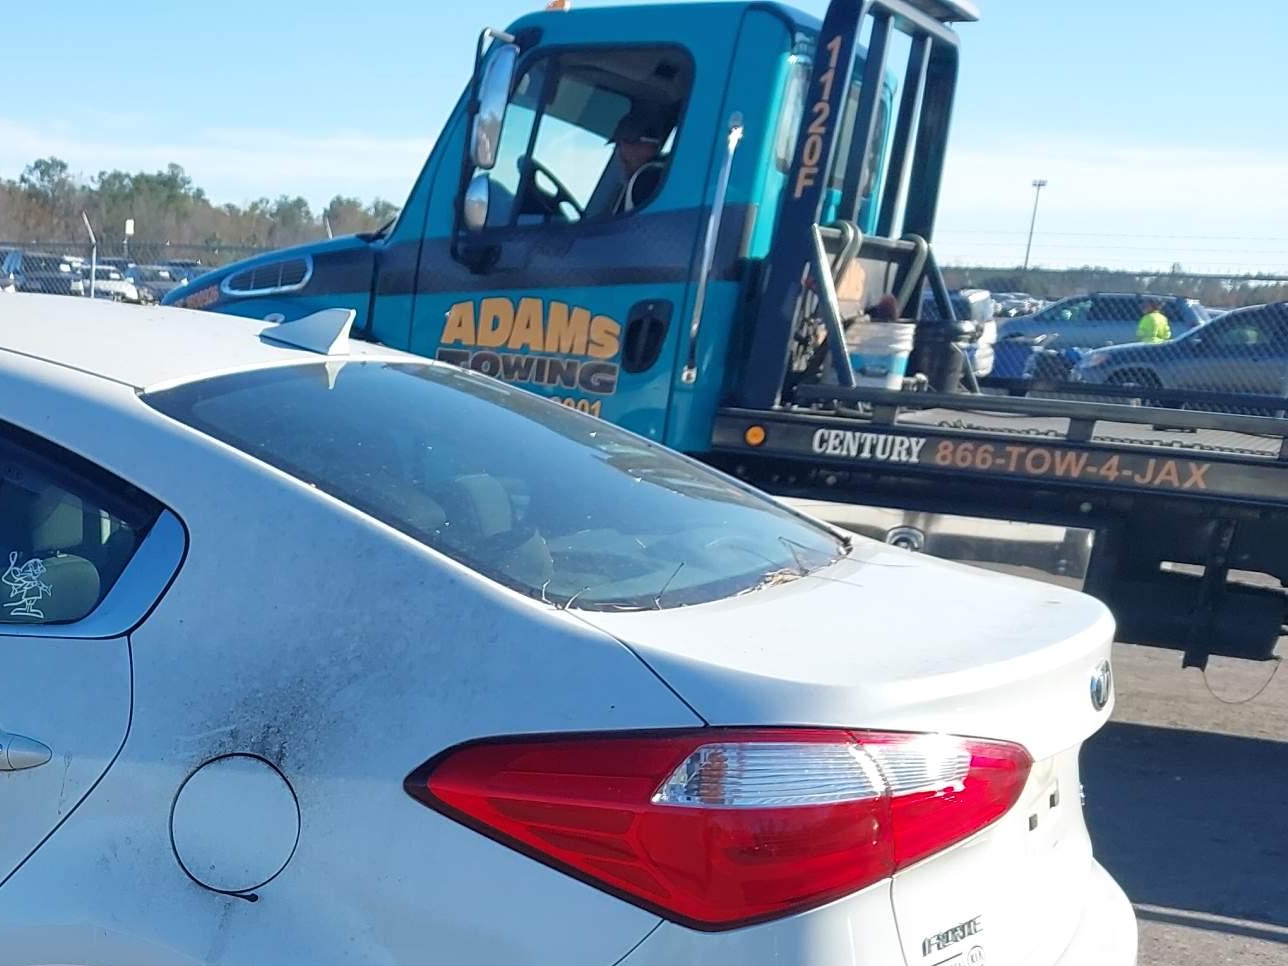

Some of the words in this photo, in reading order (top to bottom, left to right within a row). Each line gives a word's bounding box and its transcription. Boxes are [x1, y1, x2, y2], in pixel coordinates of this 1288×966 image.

[794, 35, 842, 198] 1120F
[440, 297, 621, 360] ADAMS
[436, 348, 619, 395] TOWING
[812, 428, 926, 464] CENTURY
[935, 440, 1210, 489] 866-TOW-4-JAX
